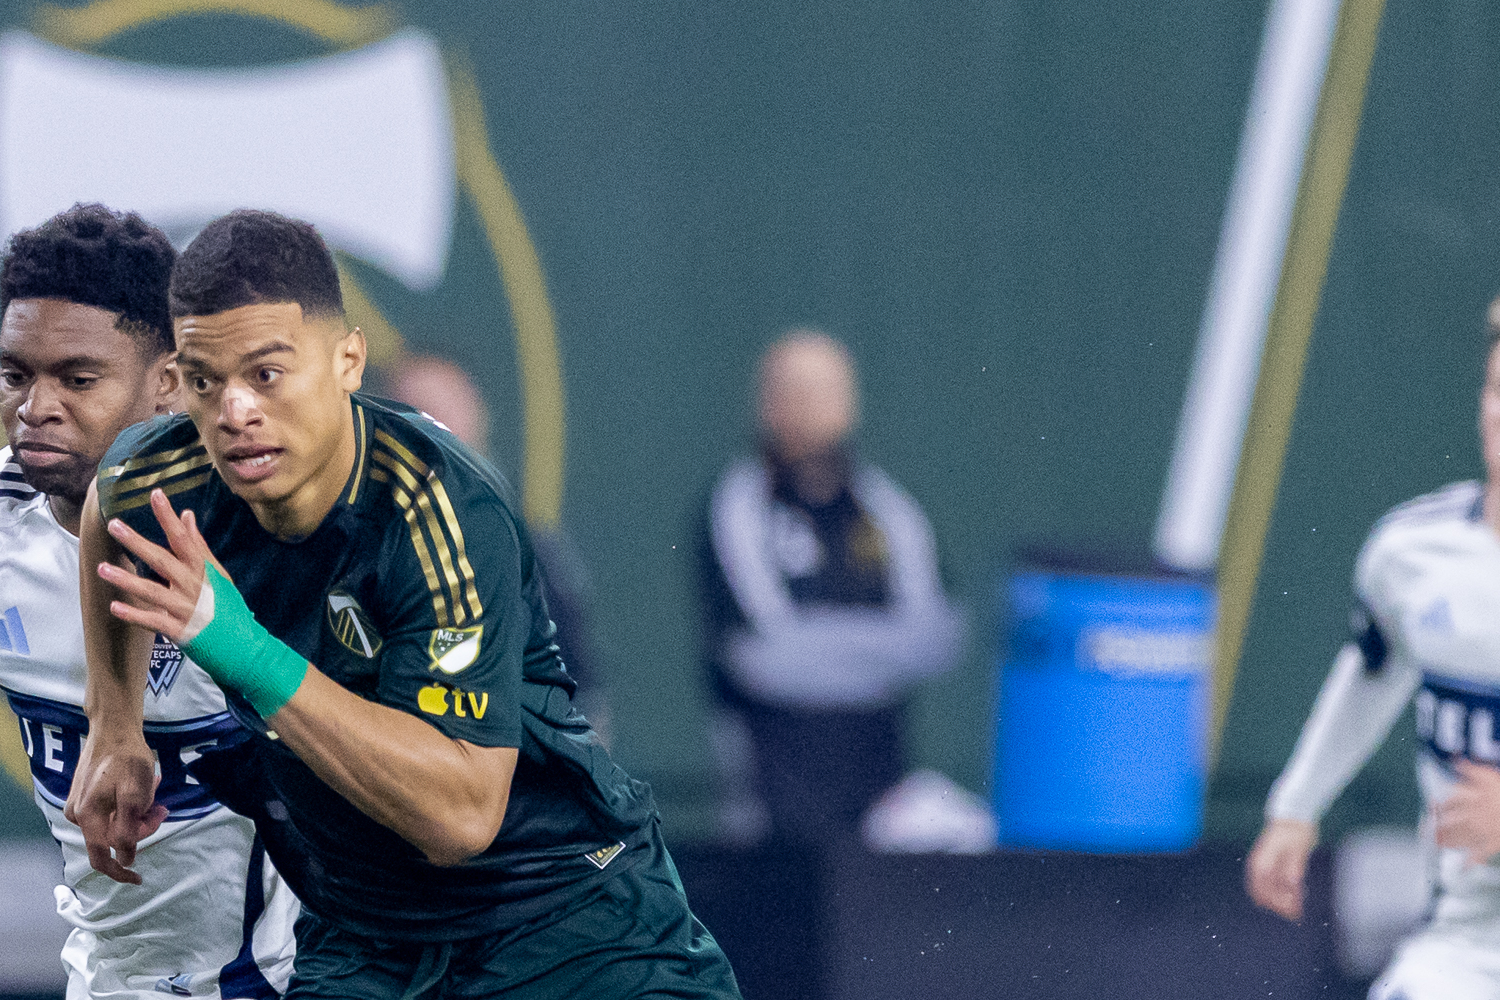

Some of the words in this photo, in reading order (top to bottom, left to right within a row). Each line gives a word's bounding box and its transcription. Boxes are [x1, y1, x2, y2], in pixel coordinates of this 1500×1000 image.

[437, 629, 464, 642] MLS
[152, 650, 182, 660] ECAPS
[150, 660, 161, 668] FC
[452, 688, 489, 719] tv
